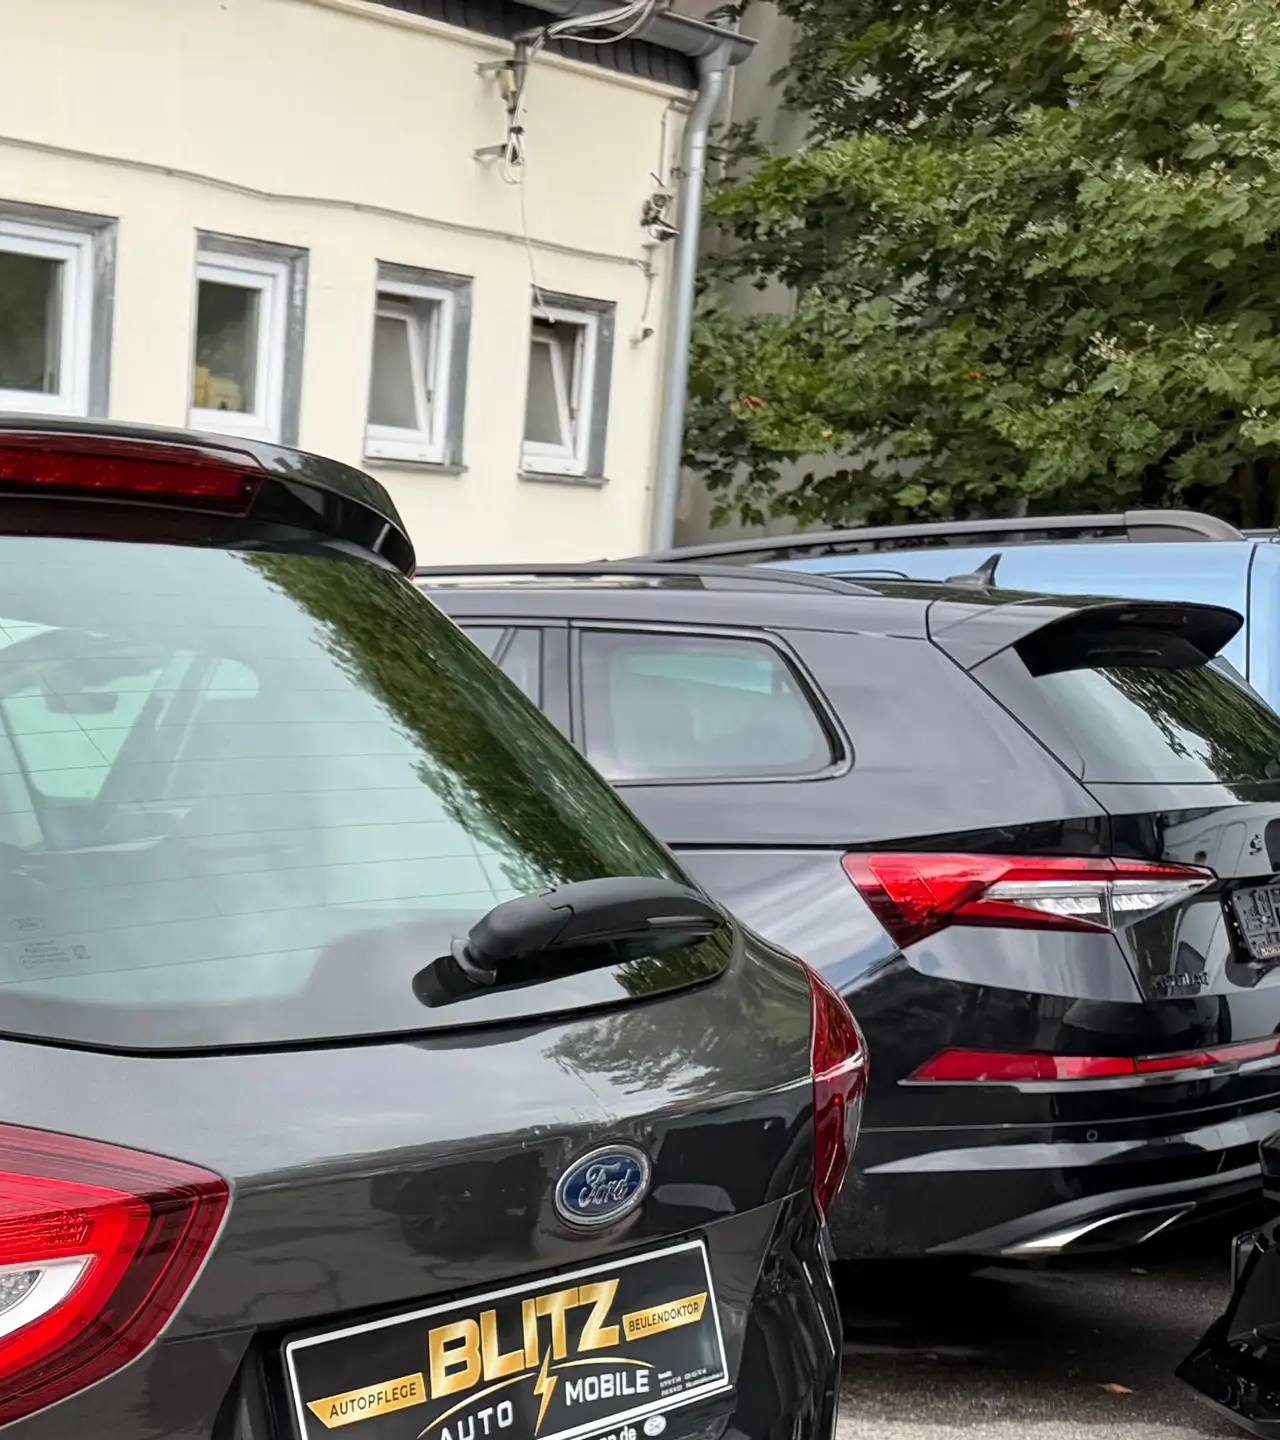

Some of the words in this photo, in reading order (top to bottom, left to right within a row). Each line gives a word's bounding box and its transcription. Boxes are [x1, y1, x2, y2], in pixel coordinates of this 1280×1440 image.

[578, 1162, 631, 1208] Ford
[628, 1301, 700, 1332] BEULENDOKTOR
[428, 1278, 620, 1400] BLITZ
[329, 1380, 418, 1419] AUTOPFLEGE
[565, 1369, 650, 1407] MOBILE
